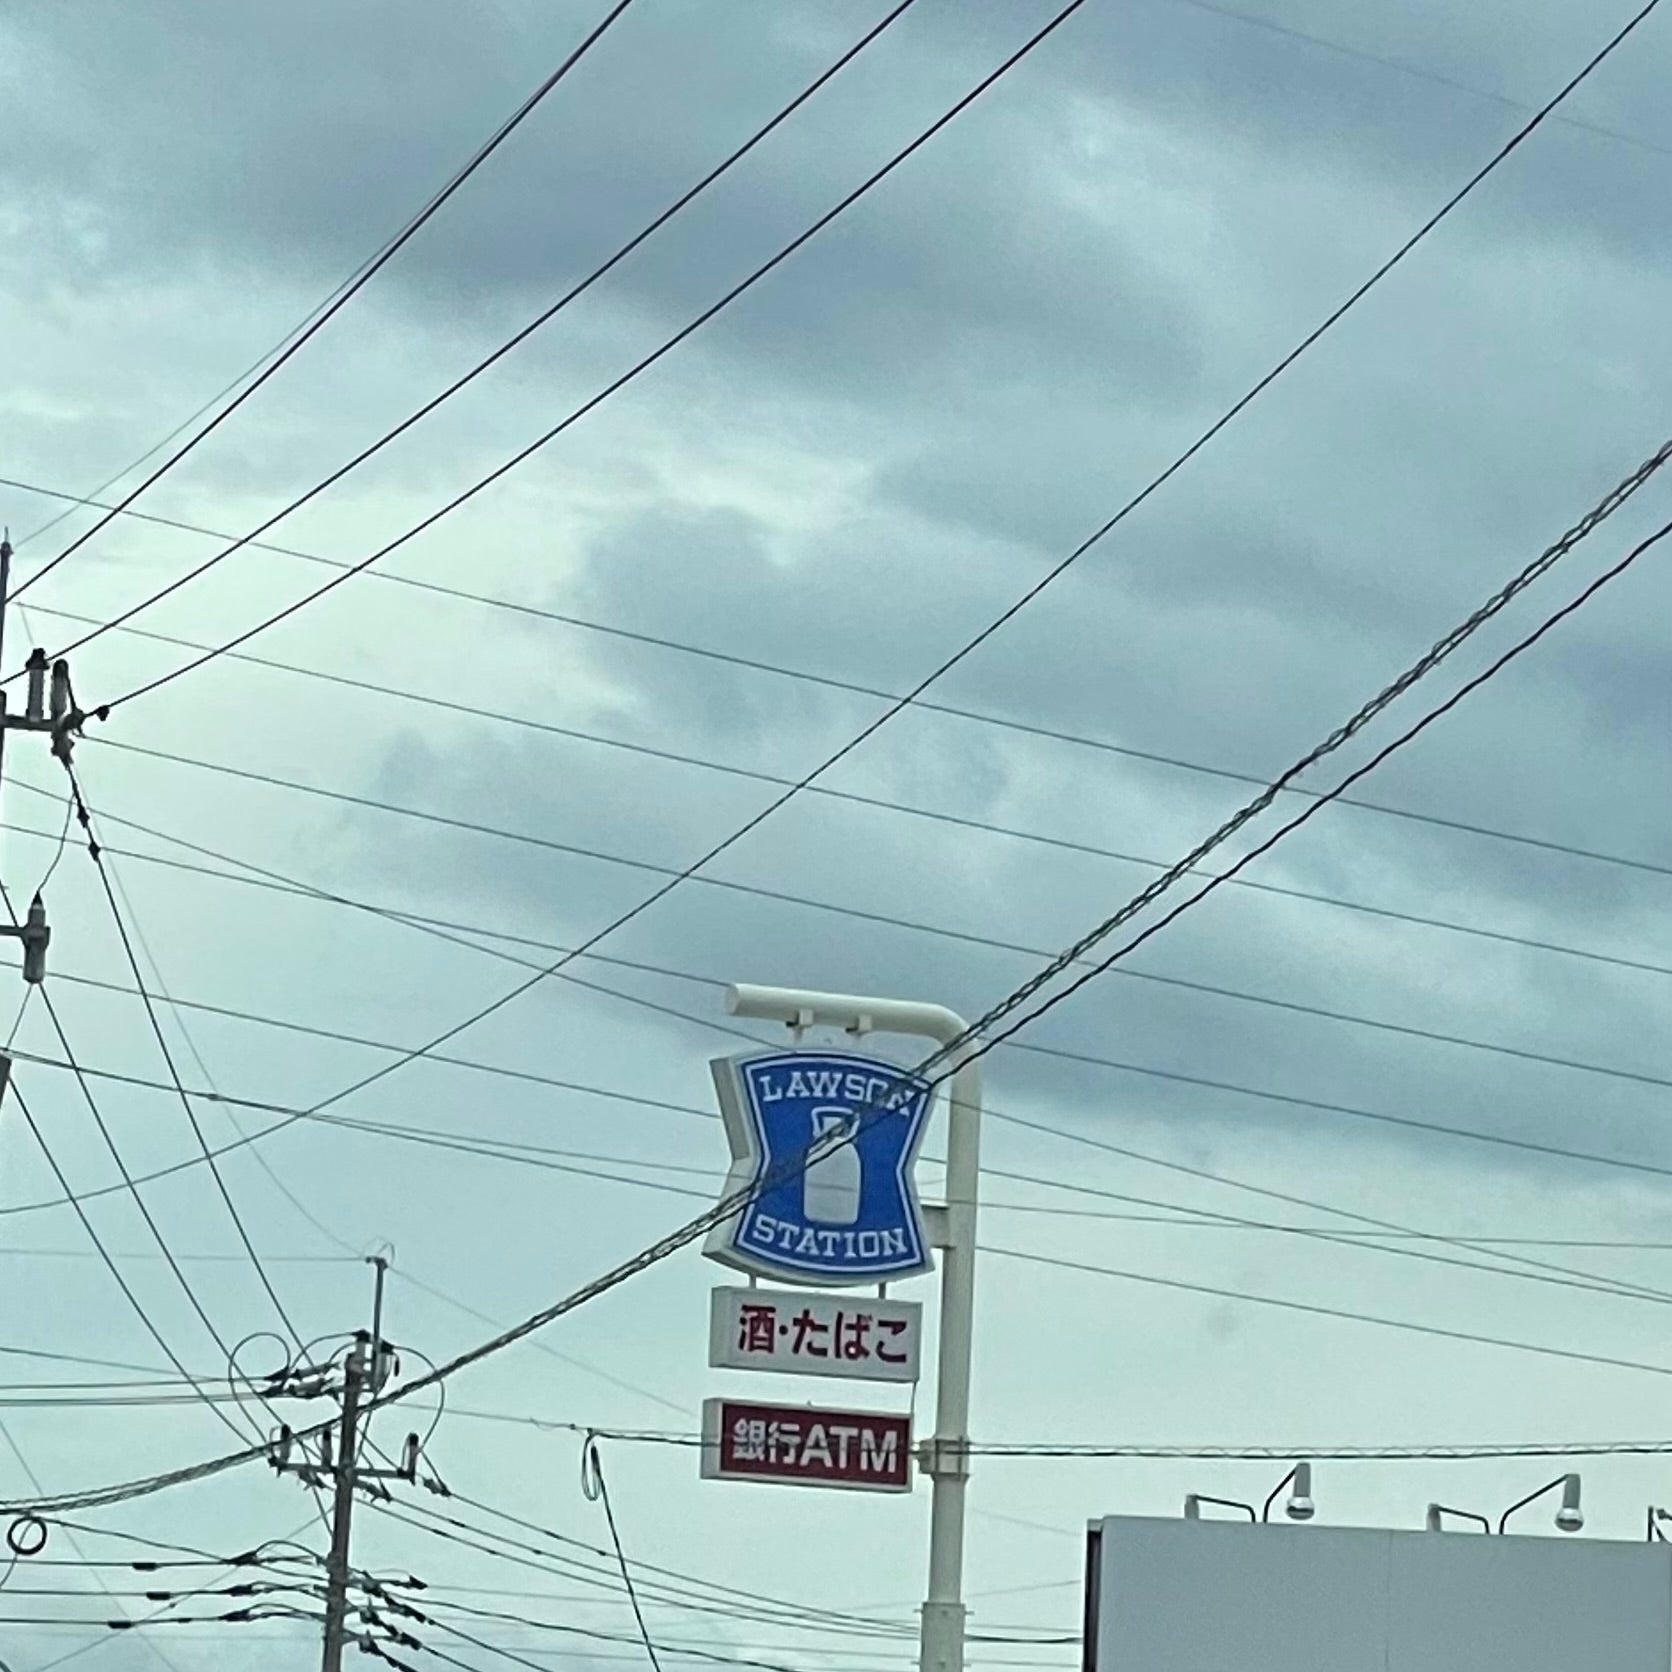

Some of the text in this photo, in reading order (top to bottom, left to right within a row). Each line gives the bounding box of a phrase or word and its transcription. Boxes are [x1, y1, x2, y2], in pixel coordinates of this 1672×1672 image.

[753, 1214, 907, 1258] STATION
[738, 1304, 907, 1363] 酒・たばこ
[732, 1417, 897, 1473] 銀行ATM
